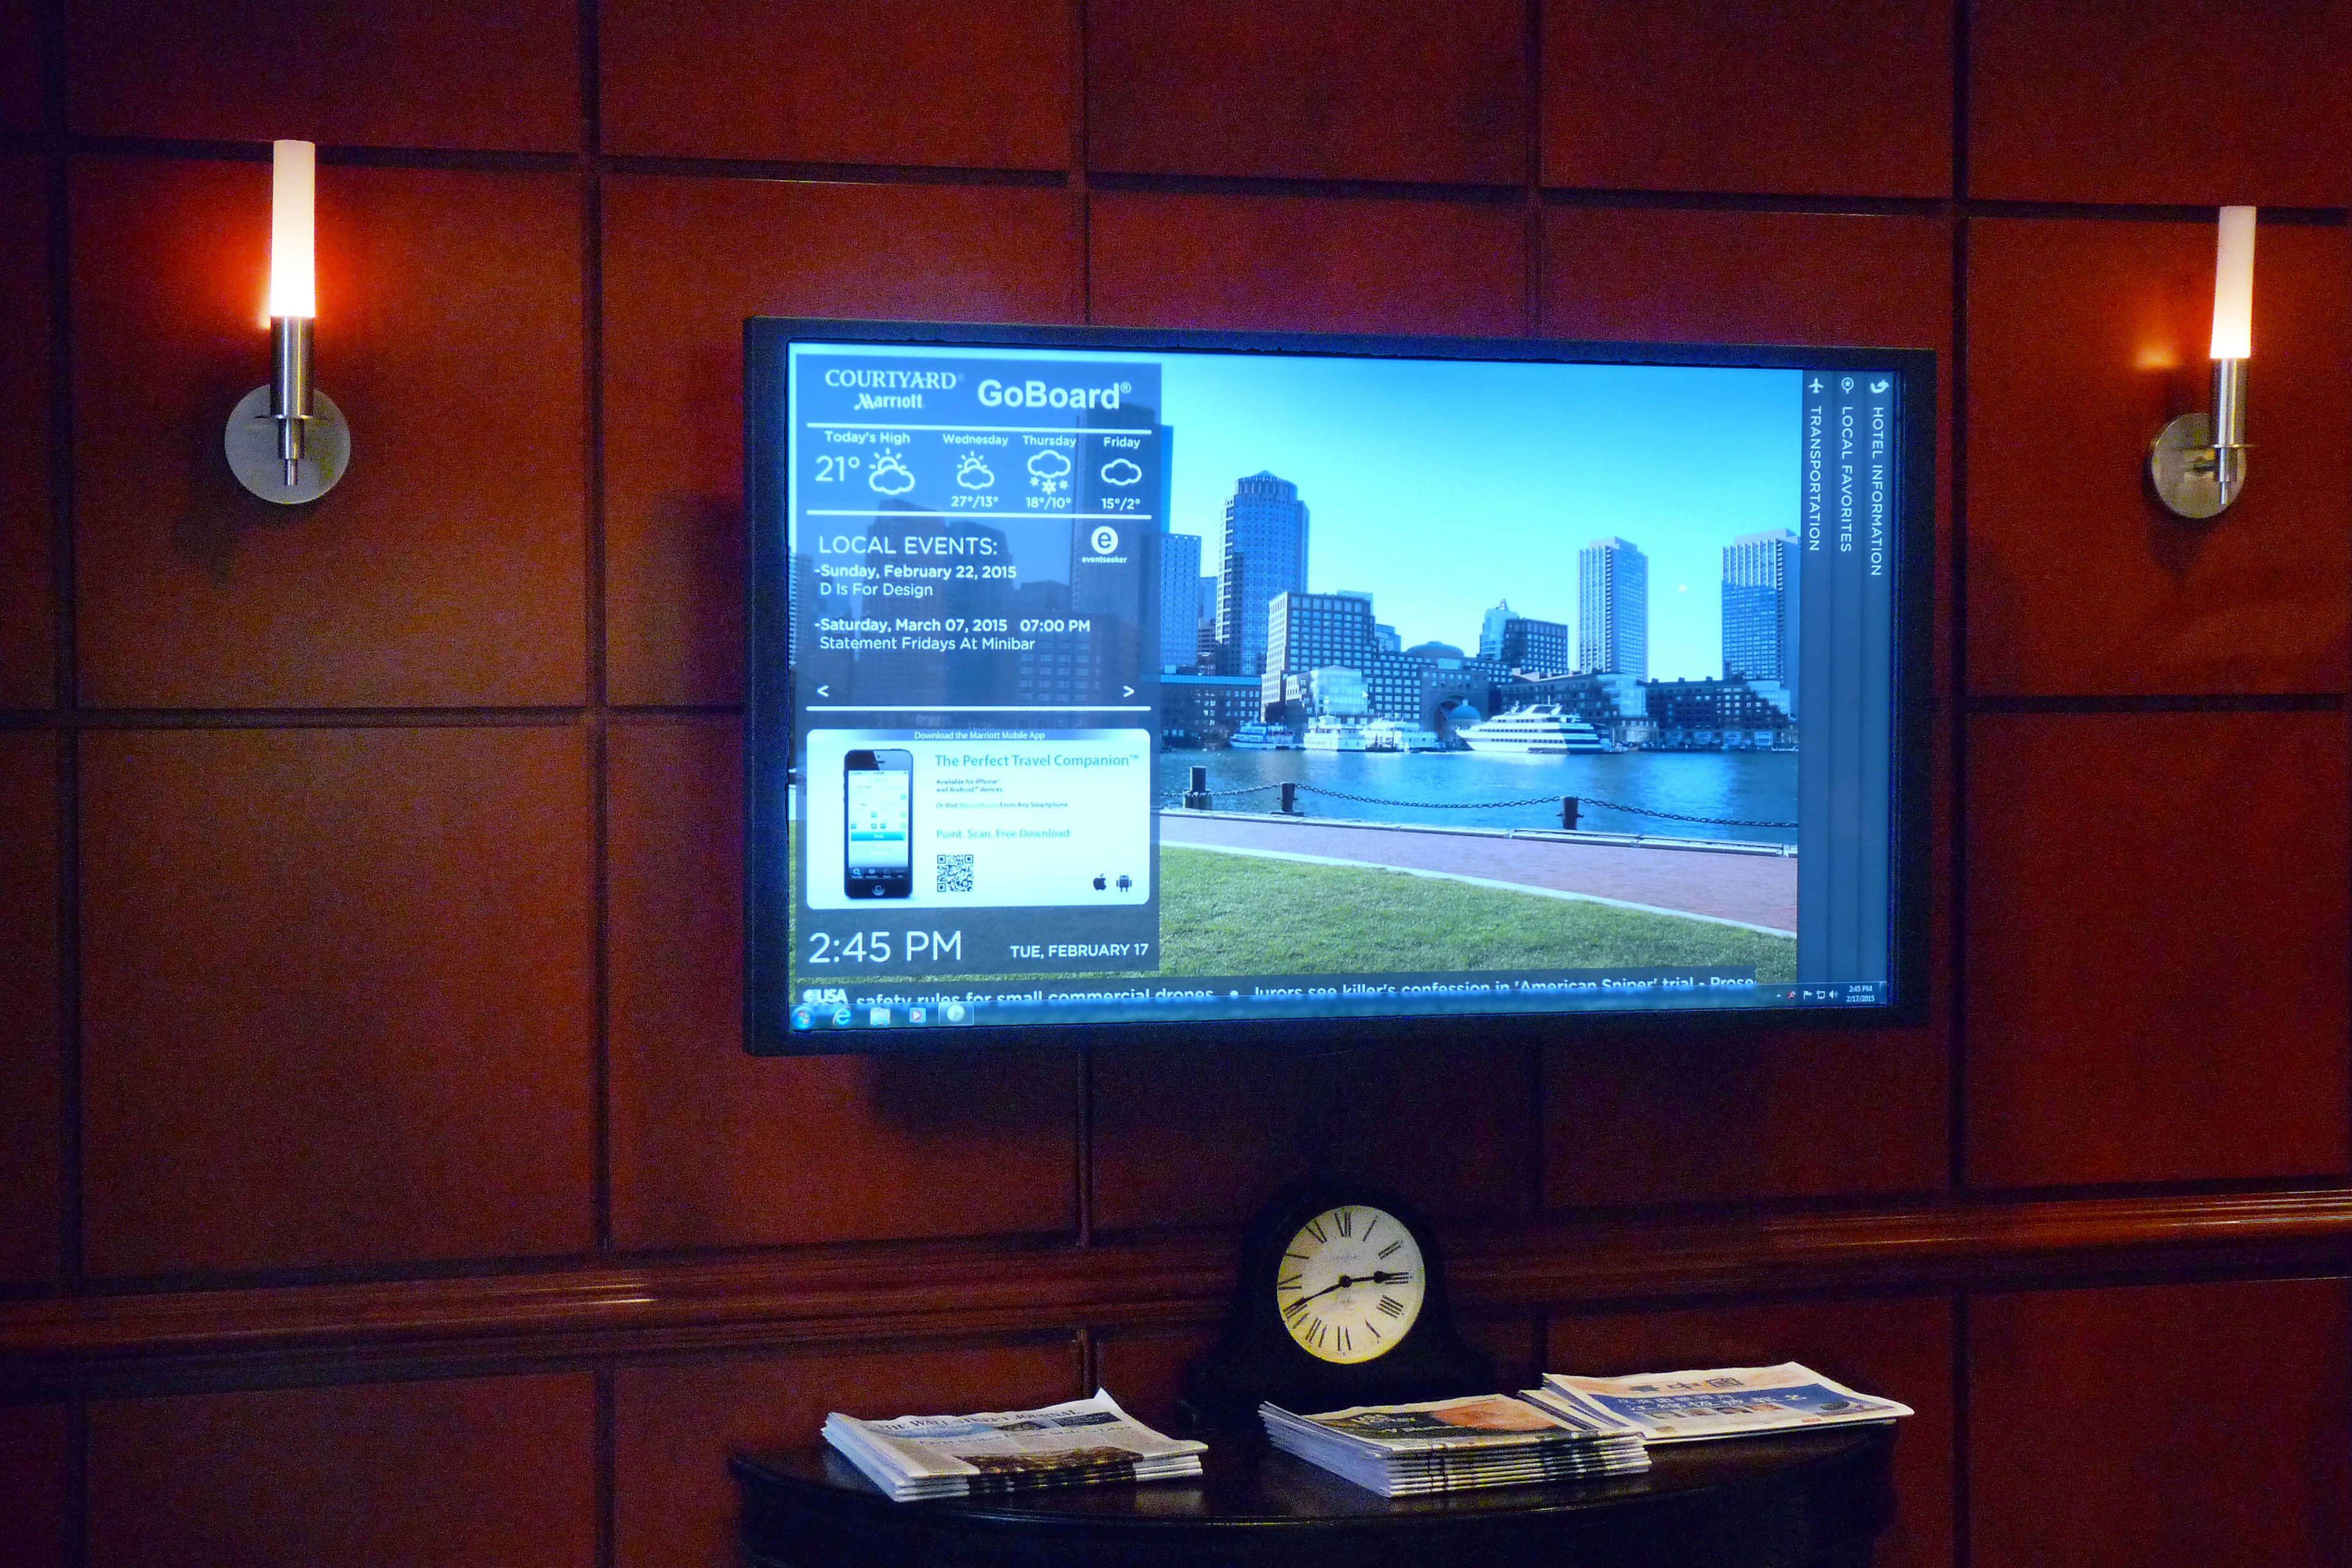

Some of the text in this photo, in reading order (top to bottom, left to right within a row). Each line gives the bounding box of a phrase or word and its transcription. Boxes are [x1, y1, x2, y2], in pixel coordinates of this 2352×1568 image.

[824, 369, 957, 390] COURTYARD
[853, 393, 923, 410] Marriott
[825, 431, 910, 444] Today's High
[943, 434, 1009, 446] Wednesday
[1023, 435, 1077, 448] Thursday
[1104, 437, 1140, 449] Friday
[815, 456, 860, 482] 21°
[1809, 405, 1822, 551] TRANSPORTATION
[1841, 407, 1853, 552] LOCAL FAVORITES
[1871, 407, 1884, 576] HOTEL INFORMATION
[819, 536, 997, 556] LOCAL EVENTS:
[884, 565, 951, 580] February
[956, 566, 979, 579] 22,
[982, 566, 1017, 579] 2015
[820, 583, 933, 598] D Is For Design
[895, 619, 941, 631] March
[945, 619, 969, 633] 07,
[973, 619, 1008, 632] 2015
[1020, 619, 1065, 632] 07:00
[1069, 620, 1090, 632] PM
[820, 637, 1035, 652] Statement Fridays At Minibar
[914, 731, 1045, 741] Download the Marriott Mobile App
[935, 755, 959, 766] The
[963, 754, 1009, 766] Perfect
[1012, 754, 1050, 766] Travel
[996, 829, 1017, 839] Free
[1020, 829, 1070, 839] Download
[809, 931, 962, 963] 2:45 PM
[1010, 943, 1149, 959] TUE, FEBRUARY 17
[817, 989, 848, 1005] USA
[856, 992, 911, 1005] safety
[918, 992, 960, 1003] rules
[966, 992, 992, 1003] for
[997, 990, 1042, 1002] small
[1049, 988, 1150, 1000] commercial
[1155, 987, 1213, 998] drones
[1308, 987, 1337, 995] see
[1343, 984, 1396, 994] killer's
[1401, 981, 1490, 993] confession
[1495, 981, 1509, 990] in
[1662, 976, 1694, 987] trial
[1629, 1377, 1744, 1393] 中國
